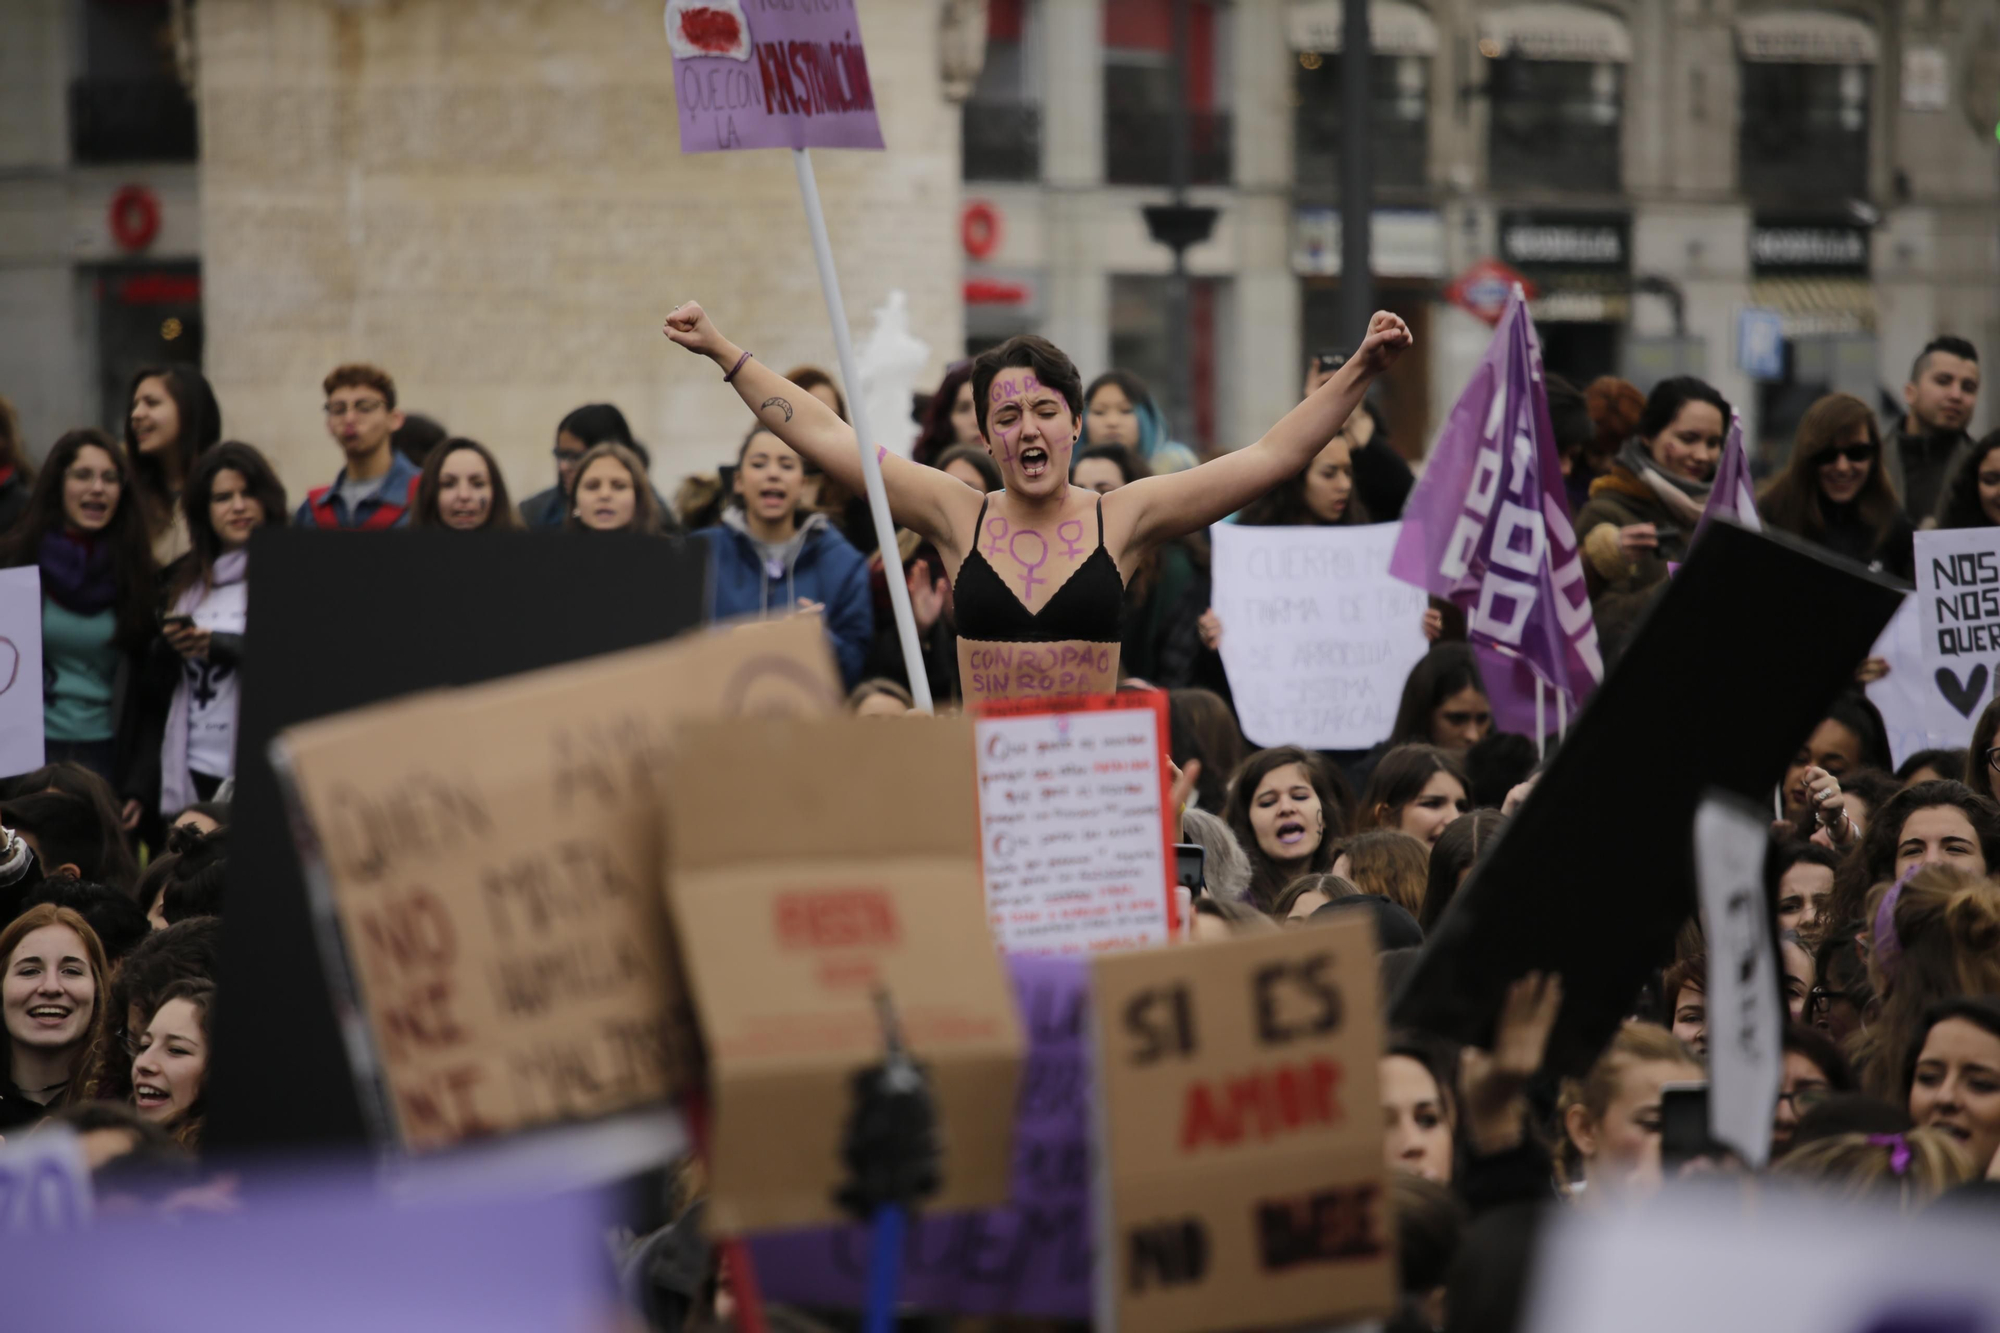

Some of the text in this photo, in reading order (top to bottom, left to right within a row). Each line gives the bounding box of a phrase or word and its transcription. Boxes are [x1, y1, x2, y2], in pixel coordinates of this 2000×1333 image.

[1932, 551, 1999, 589] NOS
[1935, 587, 2000, 623] NOS
[970, 647, 1012, 671] CON
[1017, 645, 1095, 673] ROPA
[972, 671, 1092, 694] SIN ROPA
[1123, 950, 1345, 1067] SI ES
[1179, 1055, 1347, 1155] AMOR
[1126, 1213, 1210, 1298] NO
